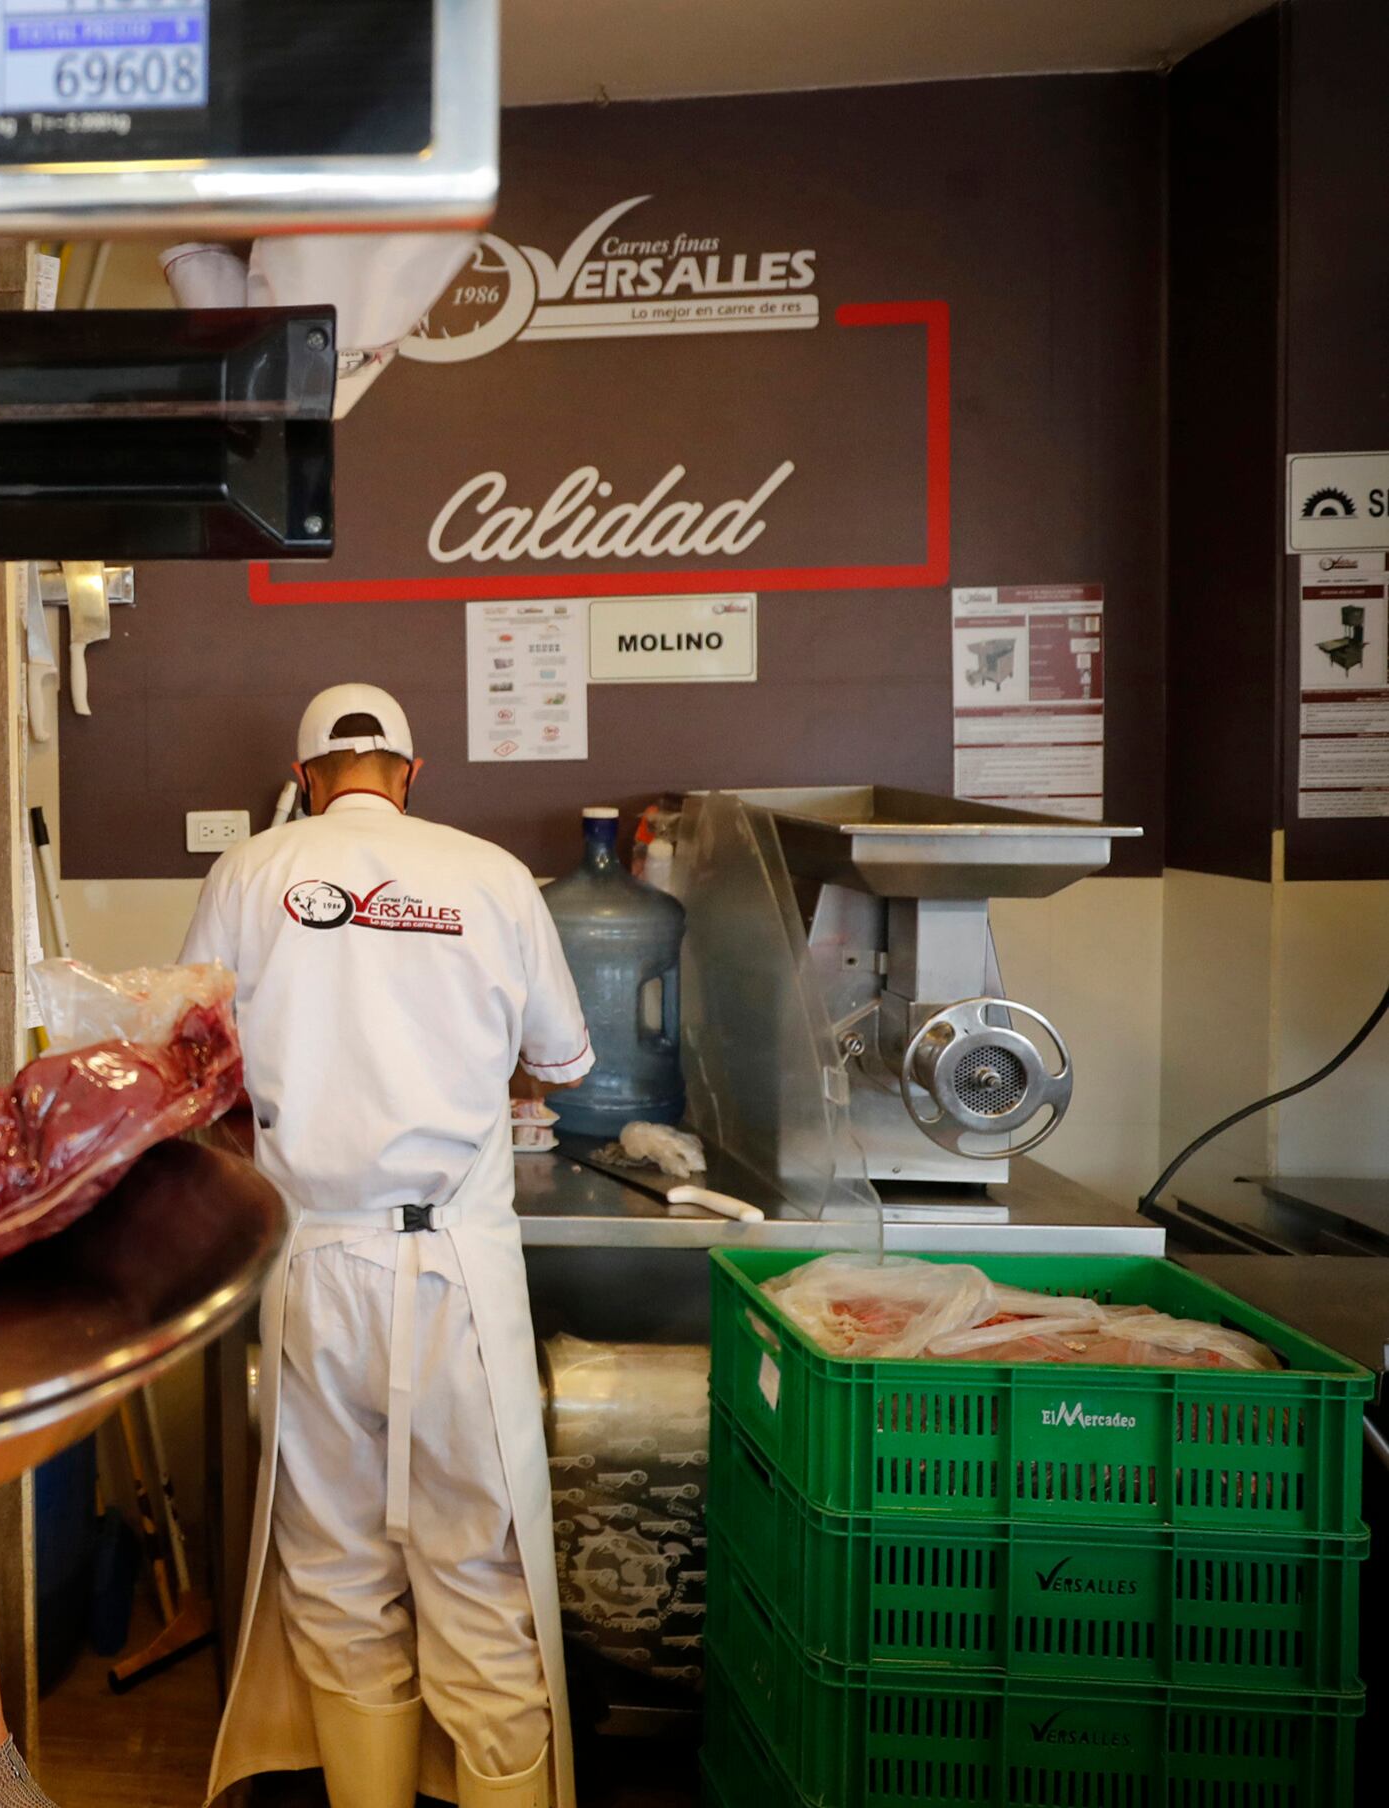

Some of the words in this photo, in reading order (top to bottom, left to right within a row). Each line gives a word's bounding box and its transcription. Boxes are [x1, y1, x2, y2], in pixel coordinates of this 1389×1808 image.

[54, 50, 198, 97] 69608
[518, 194, 816, 300] VERSALLES
[601, 236, 669, 257] Carnes
[672, 233, 720, 259] finas
[453, 286, 500, 305] 1986
[631, 307, 648, 320] Lo
[652, 306, 692, 322] mejor
[695, 306, 712, 316] en
[716, 304, 754, 316] carne
[759, 301, 777, 314] de
[781, 302, 802, 313] res
[427, 460, 795, 563] Calidad
[617, 632, 724, 653] MOLINO
[348, 880, 461, 921] VERSALLES
[1035, 1556, 1138, 1595] VERSALLES
[1028, 1707, 1131, 1745] VERSALLES
